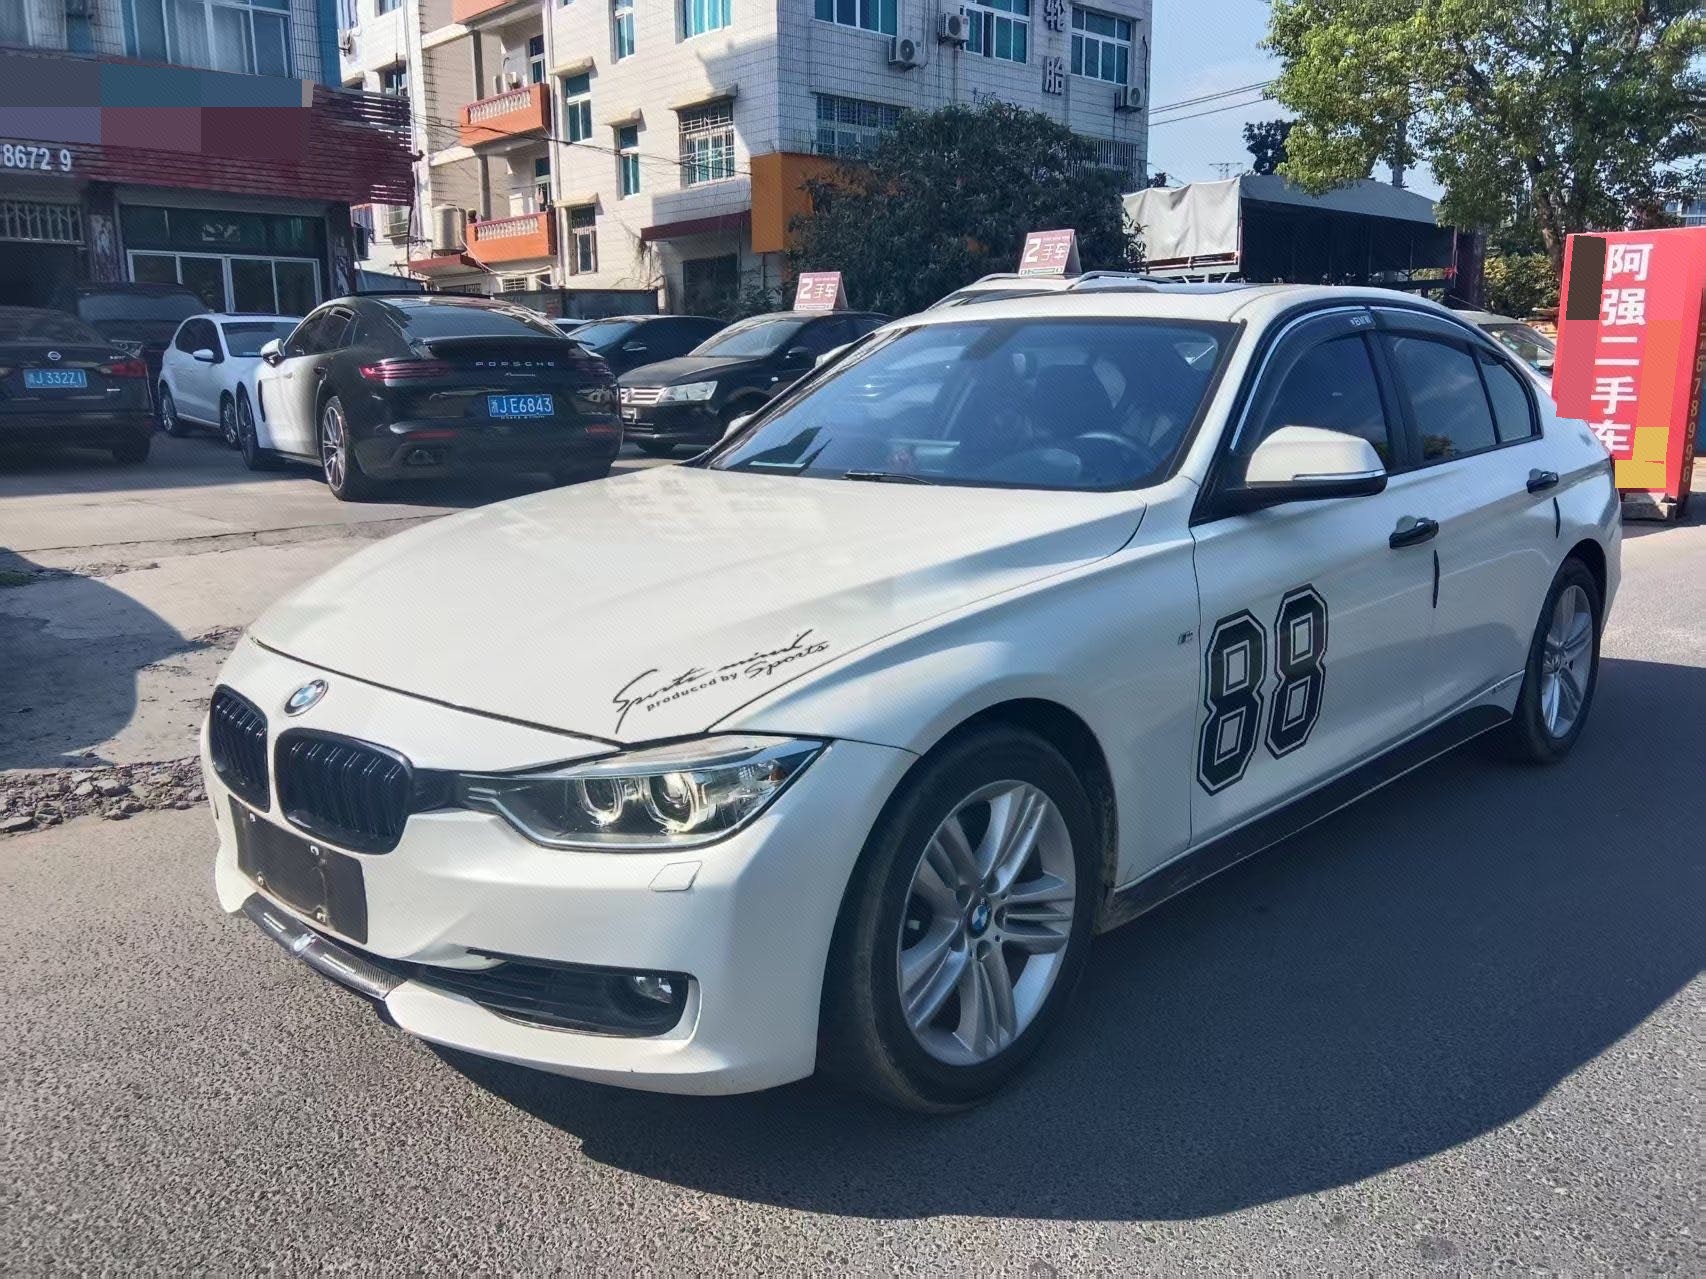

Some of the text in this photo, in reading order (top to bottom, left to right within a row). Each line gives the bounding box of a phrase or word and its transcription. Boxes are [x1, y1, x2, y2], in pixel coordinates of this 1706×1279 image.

[0, 143, 52, 171] 8672
[1589, 243, 1654, 451] 阿强二手车
[646, 640, 829, 712] produced by Sports
[1196, 583, 1329, 797] 88
